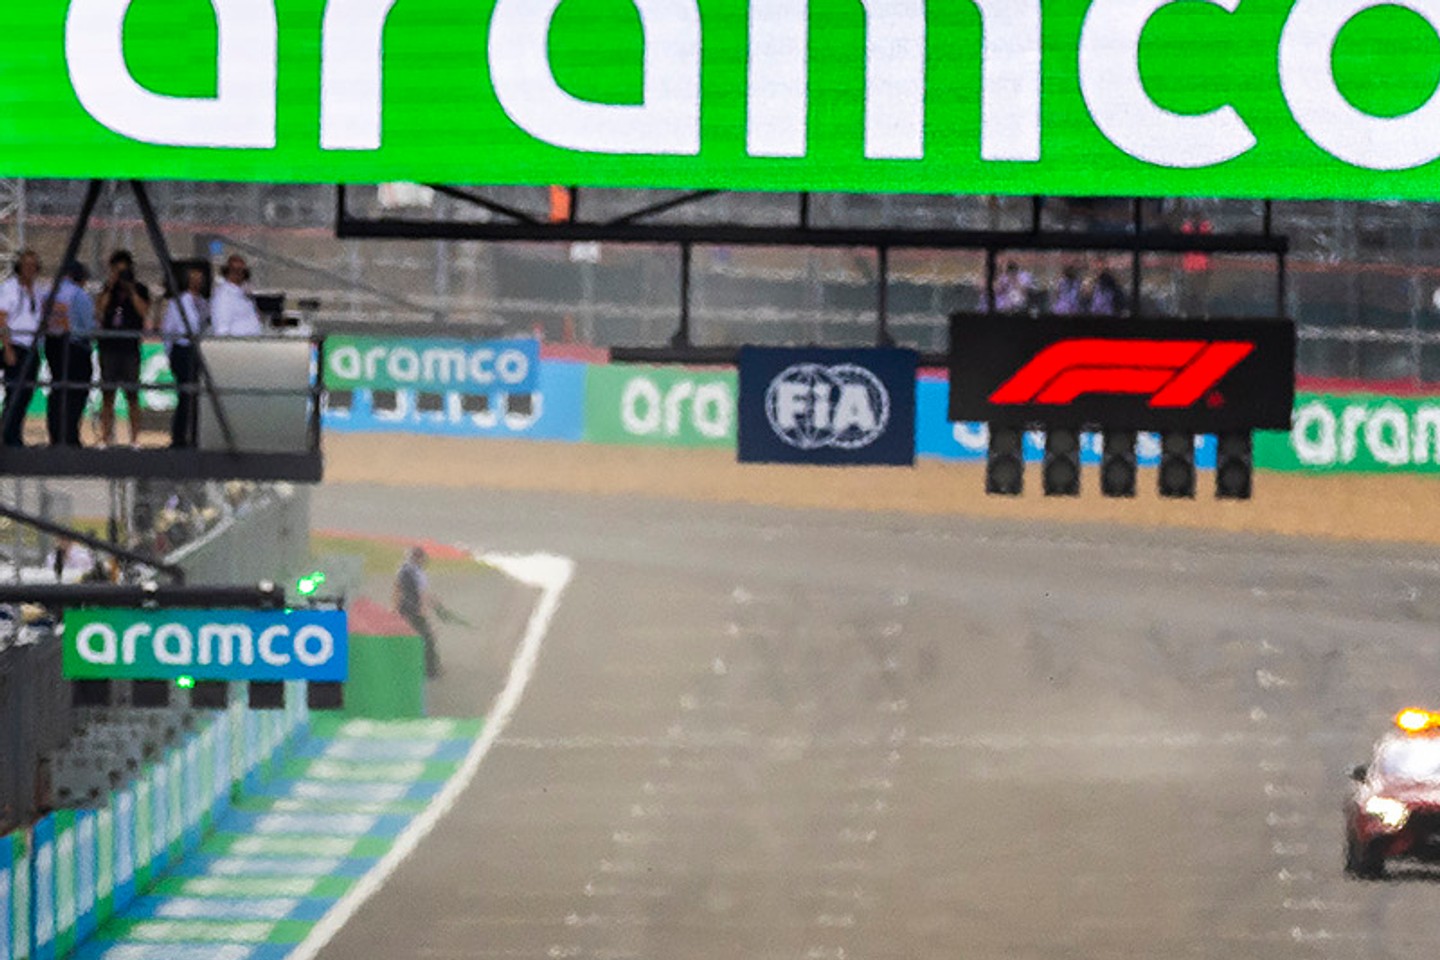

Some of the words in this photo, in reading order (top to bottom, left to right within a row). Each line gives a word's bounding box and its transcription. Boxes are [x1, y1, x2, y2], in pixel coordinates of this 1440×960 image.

[330, 346, 528, 385] aramco
[988, 338, 1255, 406] F1
[621, 376, 734, 438] ara
[775, 381, 878, 431] FIA
[76, 623, 334, 666] aramco
